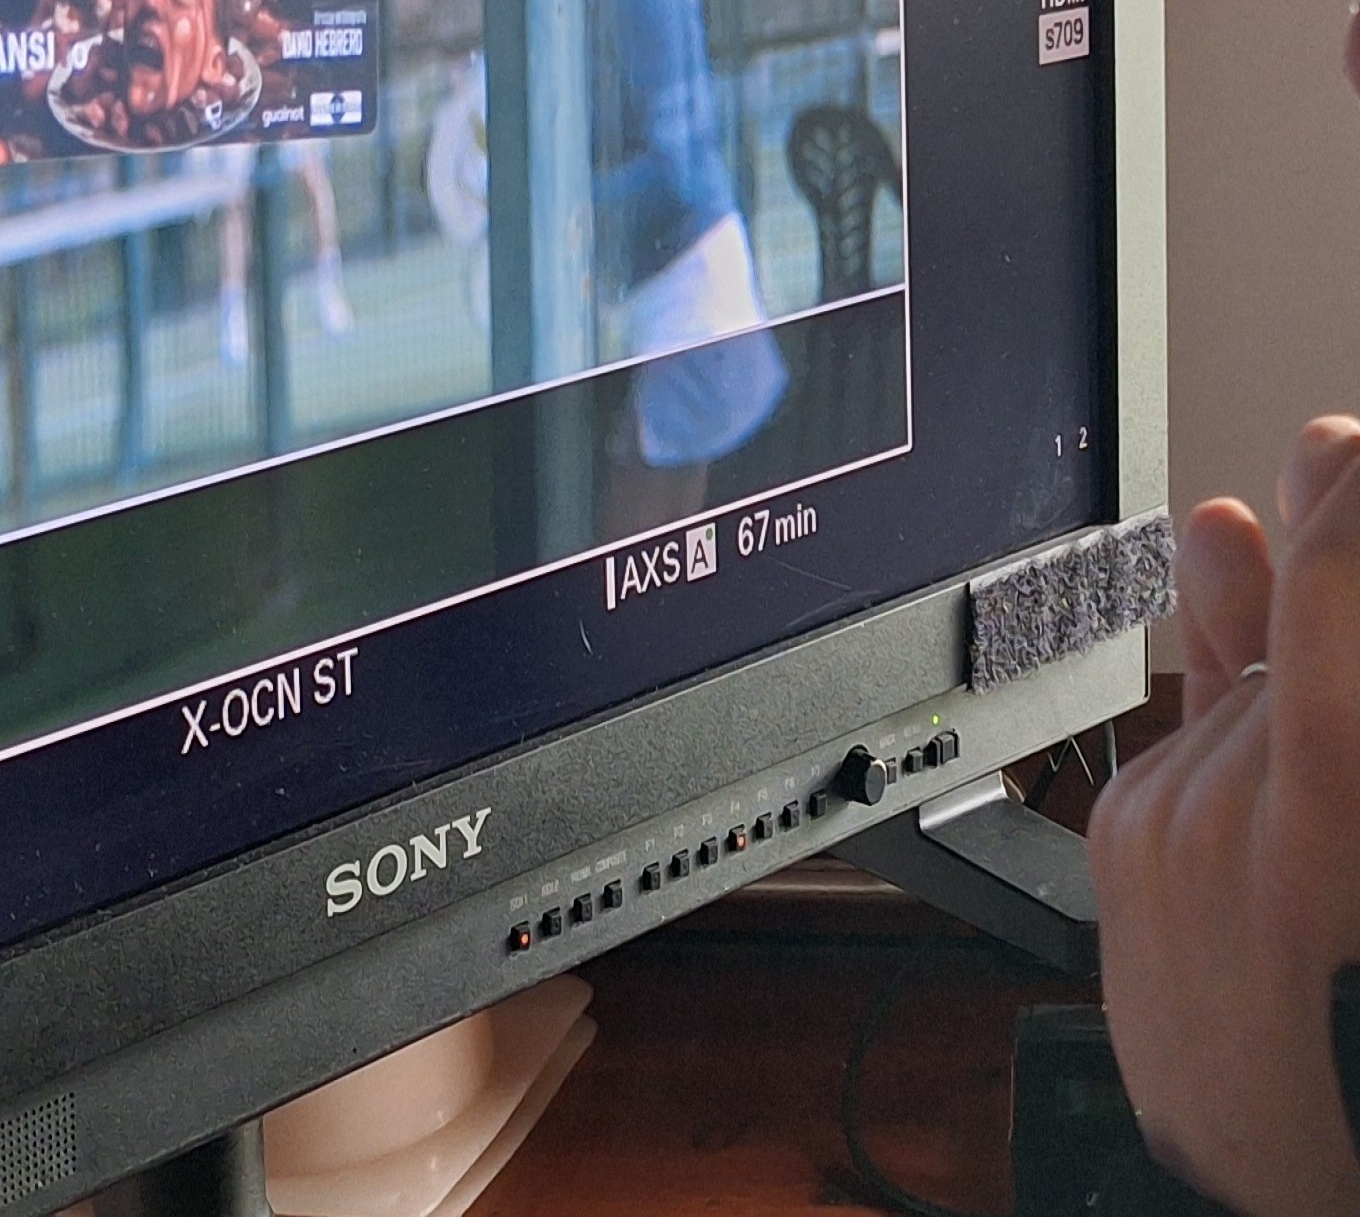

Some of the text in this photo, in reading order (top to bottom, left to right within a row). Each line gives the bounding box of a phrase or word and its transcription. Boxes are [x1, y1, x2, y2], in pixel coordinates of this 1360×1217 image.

[1045, 17, 1084, 51] s709
[1055, 426, 1088, 457] 1 2
[620, 541, 680, 600] AXS
[181, 648, 359, 754] X-OCN ST
[324, 807, 491, 917] SONY
